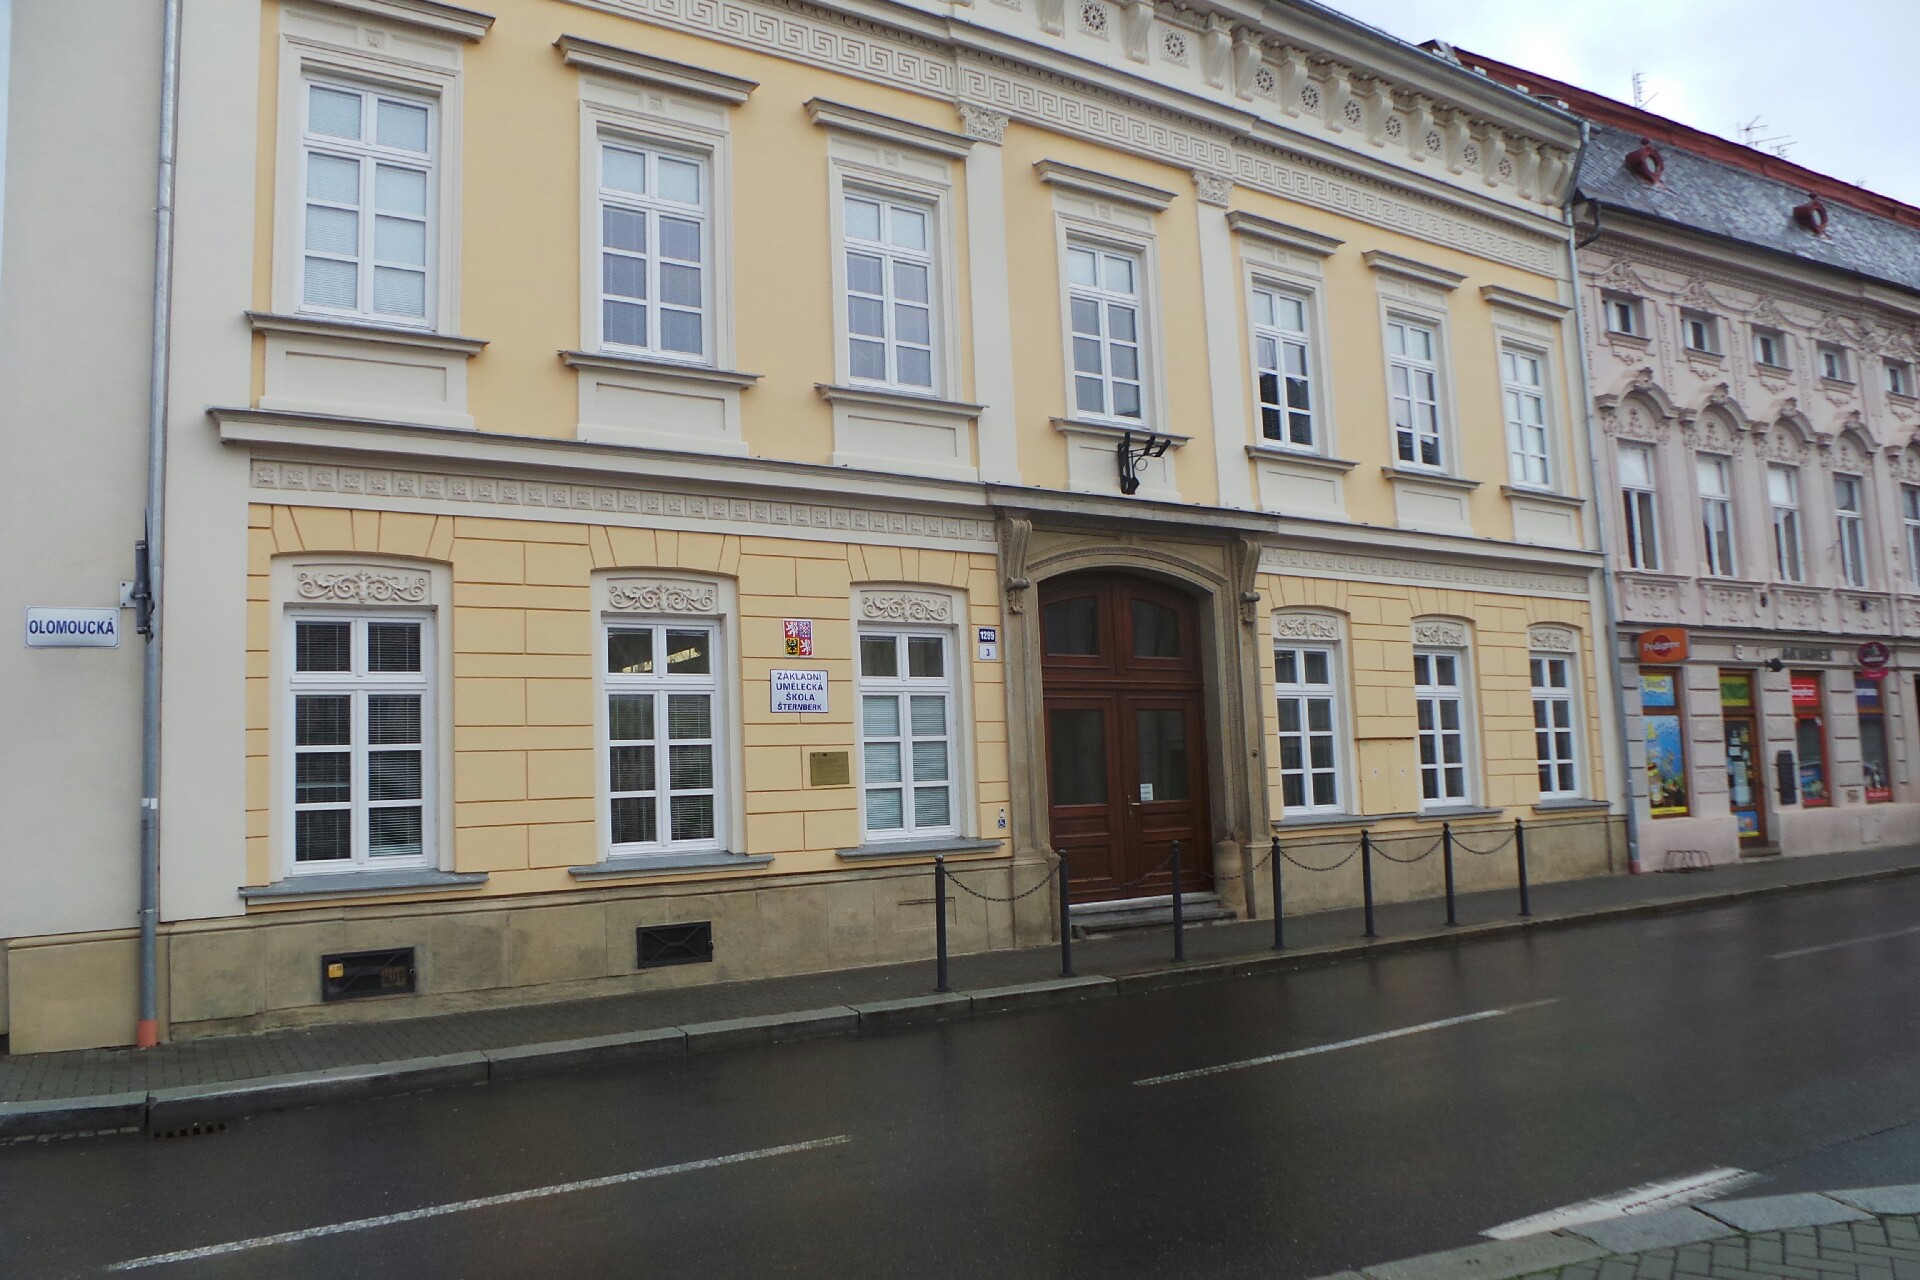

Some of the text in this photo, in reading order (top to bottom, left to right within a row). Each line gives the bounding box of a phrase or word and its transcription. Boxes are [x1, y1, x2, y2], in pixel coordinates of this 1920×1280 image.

[29, 617, 115, 635] OLOMOUCKÁ
[986, 648, 991, 657] 3
[777, 671, 822, 681] ZÁKLADNÍ
[776, 681, 823, 691] UMĚLECKÁ
[786, 692, 815, 701] ŠKOLA
[777, 702, 822, 711] ŠTERNBERK
